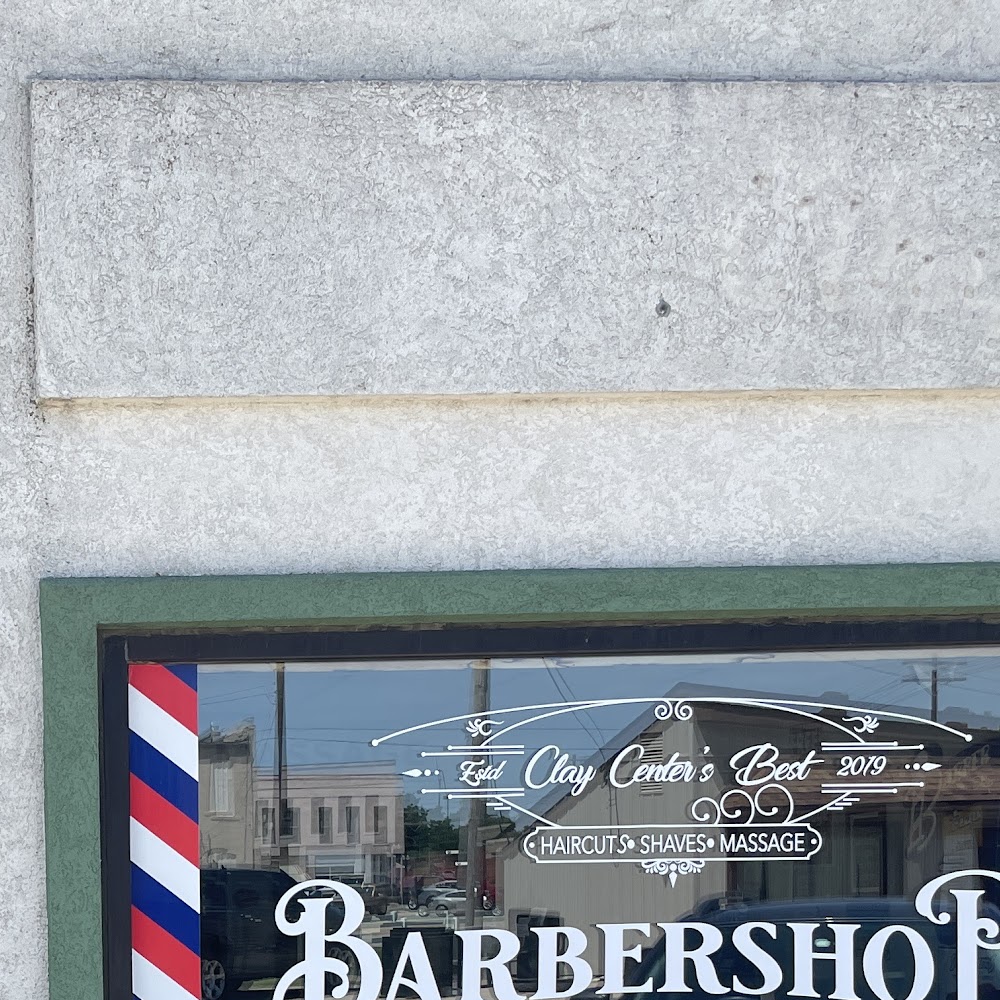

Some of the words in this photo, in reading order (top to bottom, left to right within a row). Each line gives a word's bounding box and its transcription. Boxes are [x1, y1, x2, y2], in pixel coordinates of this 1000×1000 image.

[458, 759, 507, 787] Estd
[524, 744, 597, 797] Clay
[609, 743, 715, 789] Center's
[729, 742, 825, 786] Best
[836, 755, 887, 777] 2019
[541, 834, 629, 855] HAIRCUTS
[640, 834, 706, 854] SHAVES
[719, 832, 805, 853] MASSAGE
